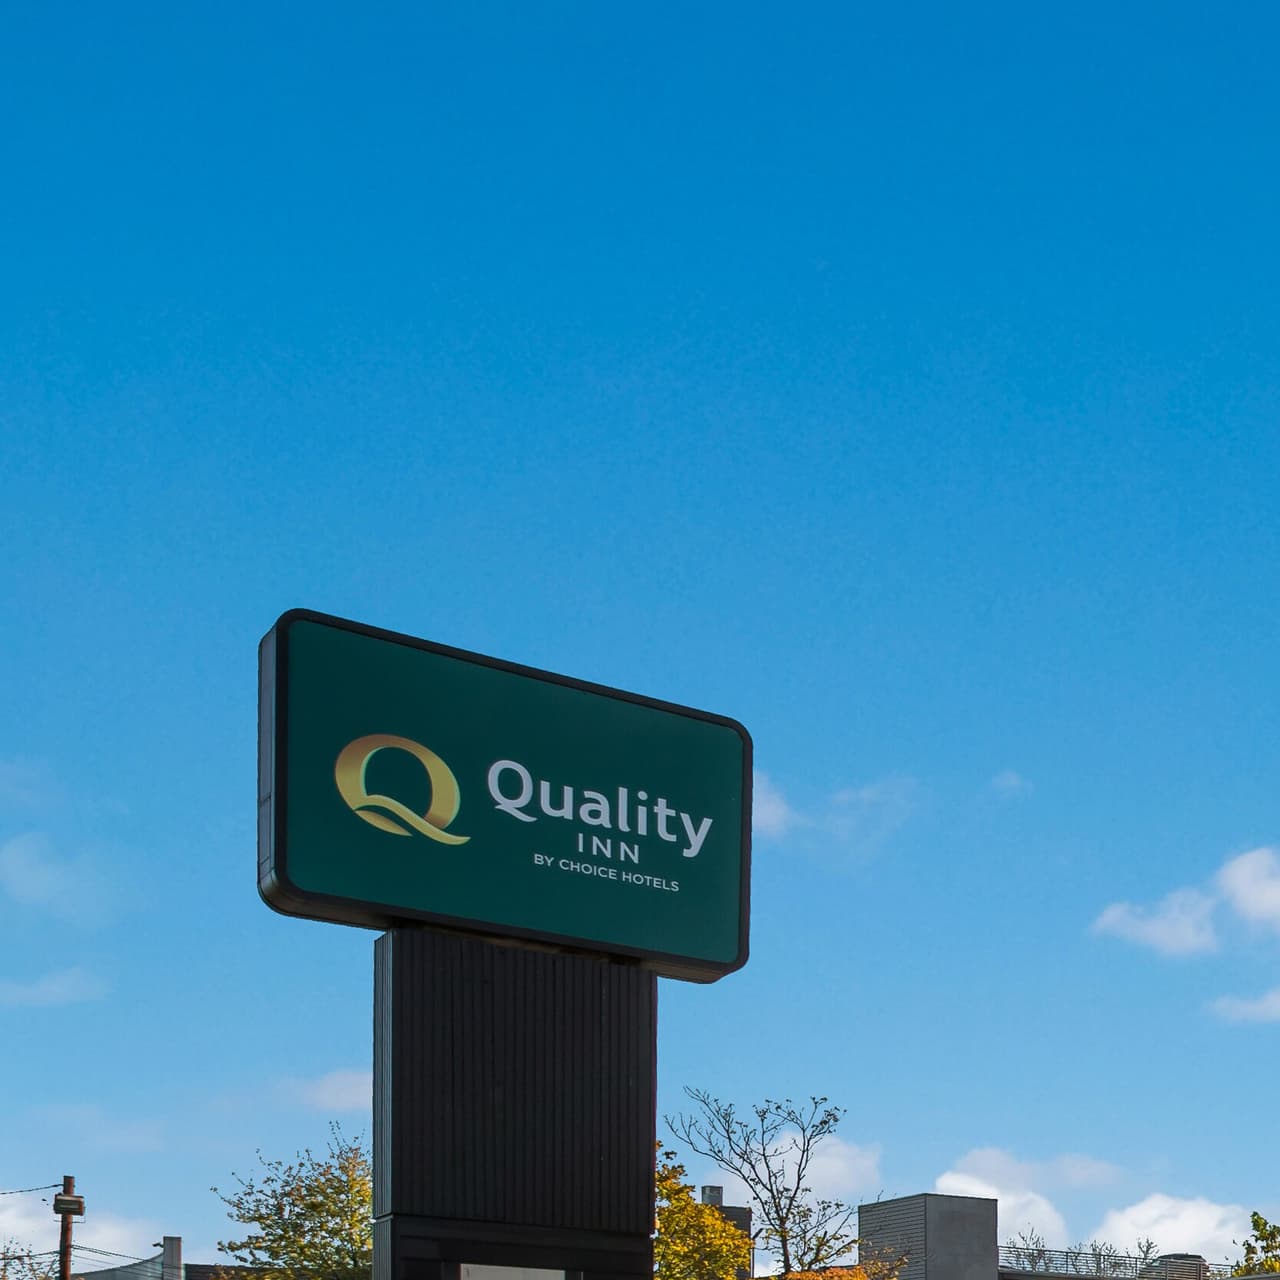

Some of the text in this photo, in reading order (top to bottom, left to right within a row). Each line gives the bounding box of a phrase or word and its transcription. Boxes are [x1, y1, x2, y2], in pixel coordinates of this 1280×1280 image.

[335, 734, 471, 845] Q
[488, 760, 713, 858] Quality
[534, 853, 680, 892] BY CHOICE HOTELS
[578, 833, 640, 864] INN
